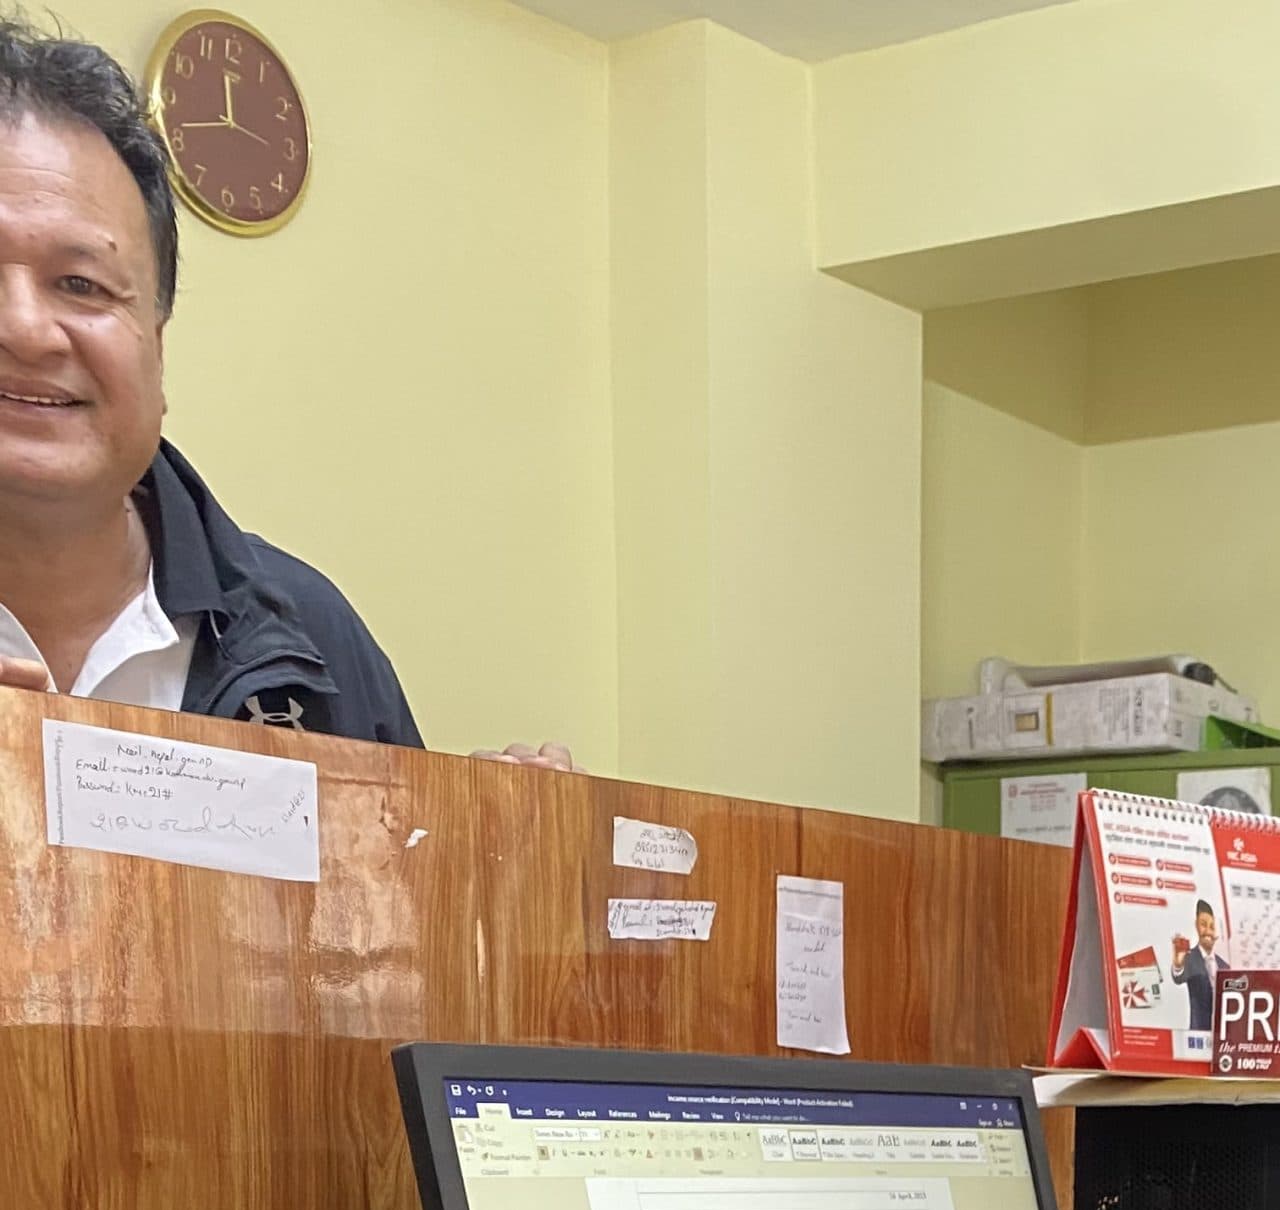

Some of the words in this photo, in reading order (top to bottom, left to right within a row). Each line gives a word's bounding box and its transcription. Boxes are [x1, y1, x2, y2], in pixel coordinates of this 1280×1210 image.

[200, 35, 213, 60] 11
[224, 37, 242, 65] 12
[175, 55, 194, 79] 10
[275, 96, 290, 120] 2
[172, 128, 184, 152] 8
[284, 137, 296, 161] 3
[193, 164, 207, 186] 7
[271, 172, 283, 193] 4
[220, 185, 235, 208] 6
[249, 186, 262, 211] 5
[1218, 1042, 1236, 1054] the
[1237, 1058, 1256, 1070] 100
[455, 1107, 467, 1115] File
[545, 1108, 565, 1118] Design
[577, 1109, 597, 1119] Layout
[608, 1109, 637, 1119] References
[649, 1110, 671, 1120] Mailings
